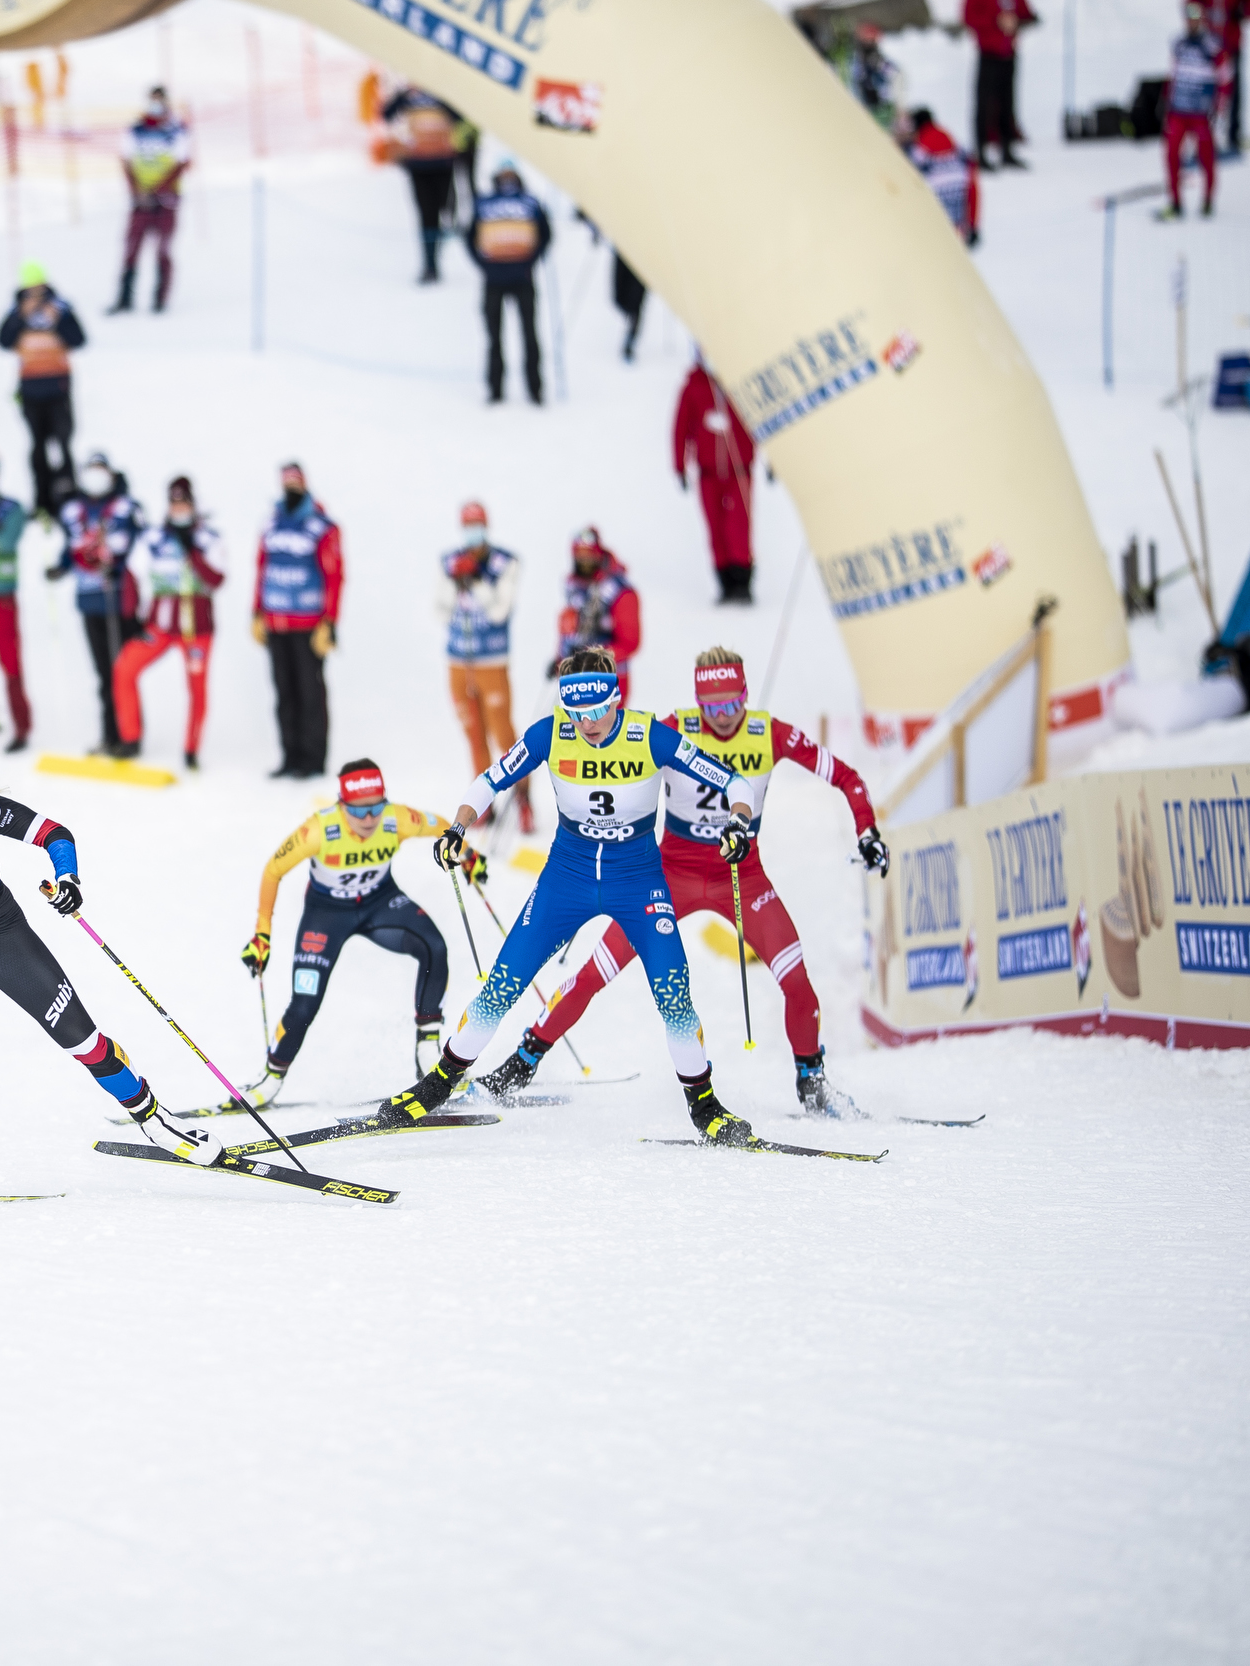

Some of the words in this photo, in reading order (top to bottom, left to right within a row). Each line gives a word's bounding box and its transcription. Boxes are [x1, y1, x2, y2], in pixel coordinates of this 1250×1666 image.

[696, 667, 738, 682] LUKOIL
[560, 680, 608, 697] gorenje
[559, 731, 576, 739] coop
[582, 760, 644, 779] BKW
[588, 790, 616, 817] 3
[578, 824, 635, 841] coop
[345, 846, 396, 866] BKW
[1163, 800, 1191, 904] LE
[986, 829, 1010, 922] LE
[225, 1140, 279, 1156] FISCHE
[321, 1181, 390, 1203] FISCHER
